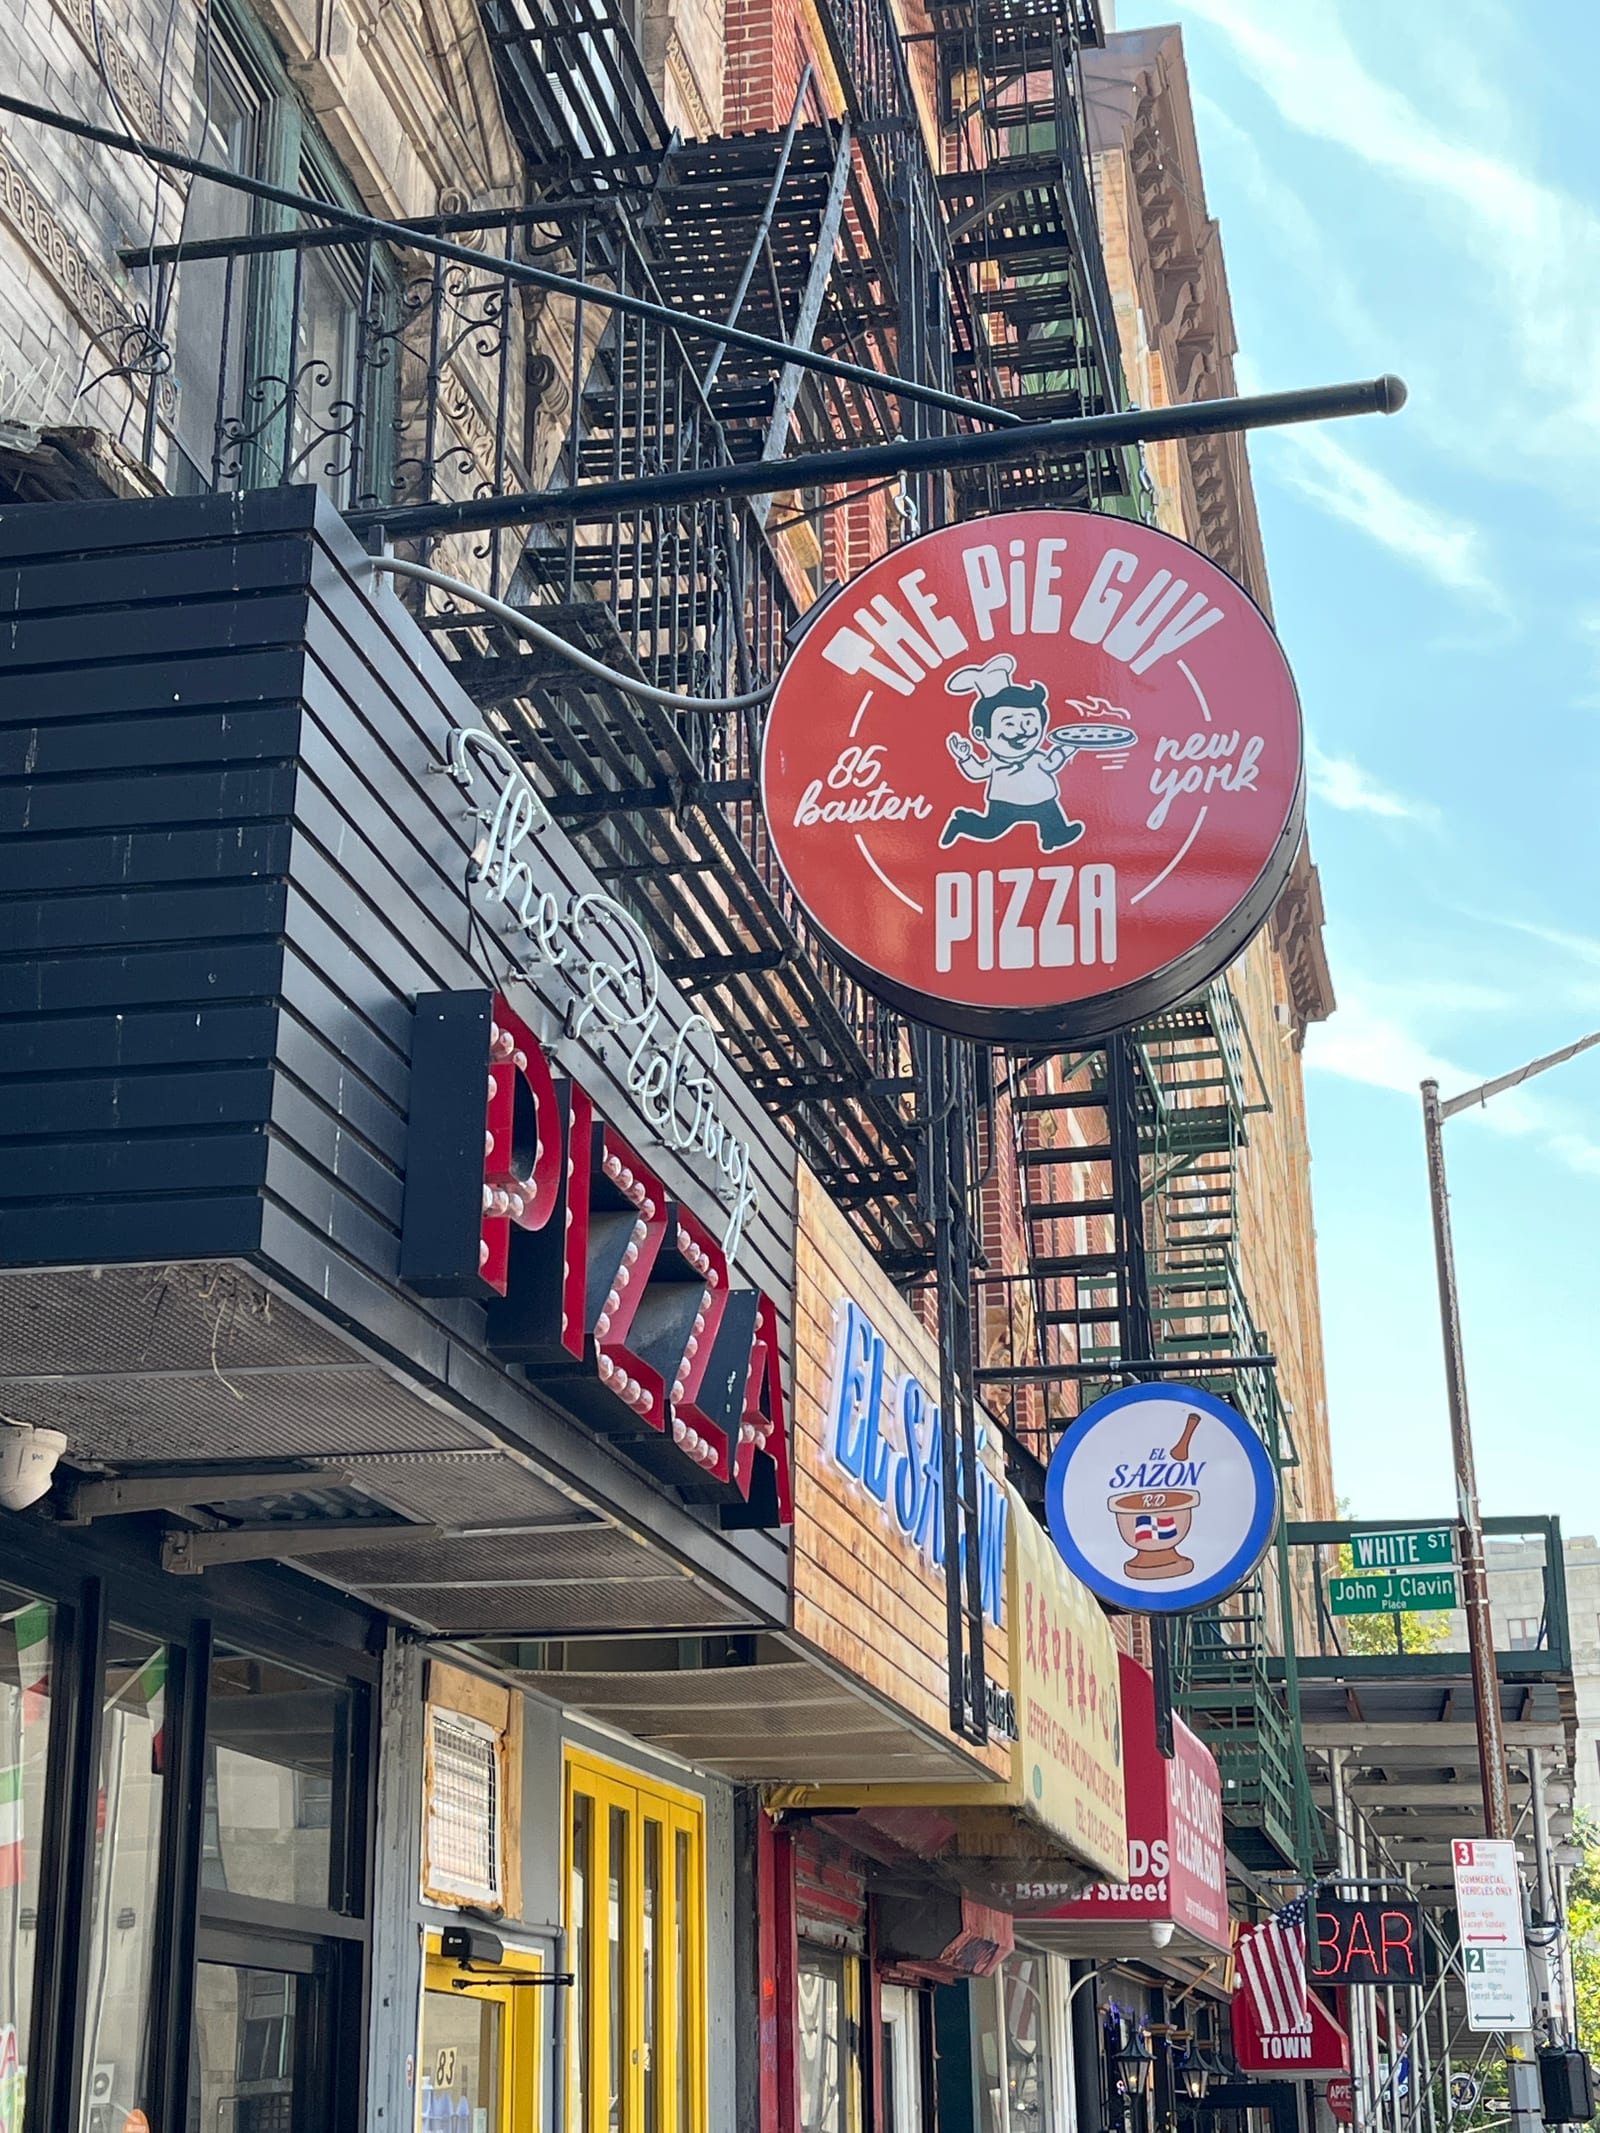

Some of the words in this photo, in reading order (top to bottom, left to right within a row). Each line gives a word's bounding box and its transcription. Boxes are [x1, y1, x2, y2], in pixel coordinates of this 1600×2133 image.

[822, 567, 968, 697] THE
[1069, 548, 1225, 676] GUY
[1153, 729, 1240, 764] new
[826, 744, 889, 790] 85
[1147, 735, 1265, 831] york
[934, 862, 1118, 974] PIZZA
[430, 988, 794, 1526] PIZZA
[830, 1298, 890, 1506] EL
[1149, 1447, 1165, 1461] EL
[1357, 1535, 1420, 1566] WHITE
[1427, 1533, 1448, 1549] ST
[1335, 1581, 1377, 1601] John
[1383, 1577, 1393, 1599] J
[1400, 1576, 1453, 1598] Clavin
[1381, 1599, 1408, 1609] Place
[1189, 1768, 1222, 1849] BONDS
[1458, 1843, 1470, 1865] 3
[1459, 1874, 1505, 1885] COMMERCIAL
[1461, 1886, 1494, 1897] VEHICLES
[1495, 1887, 1513, 1897] ONLY
[1312, 1910, 1415, 1976] BAR
[1468, 1949, 1481, 1971] 2
[1260, 2036, 1312, 2059] TOWN
[436, 2050, 456, 2087] 83
